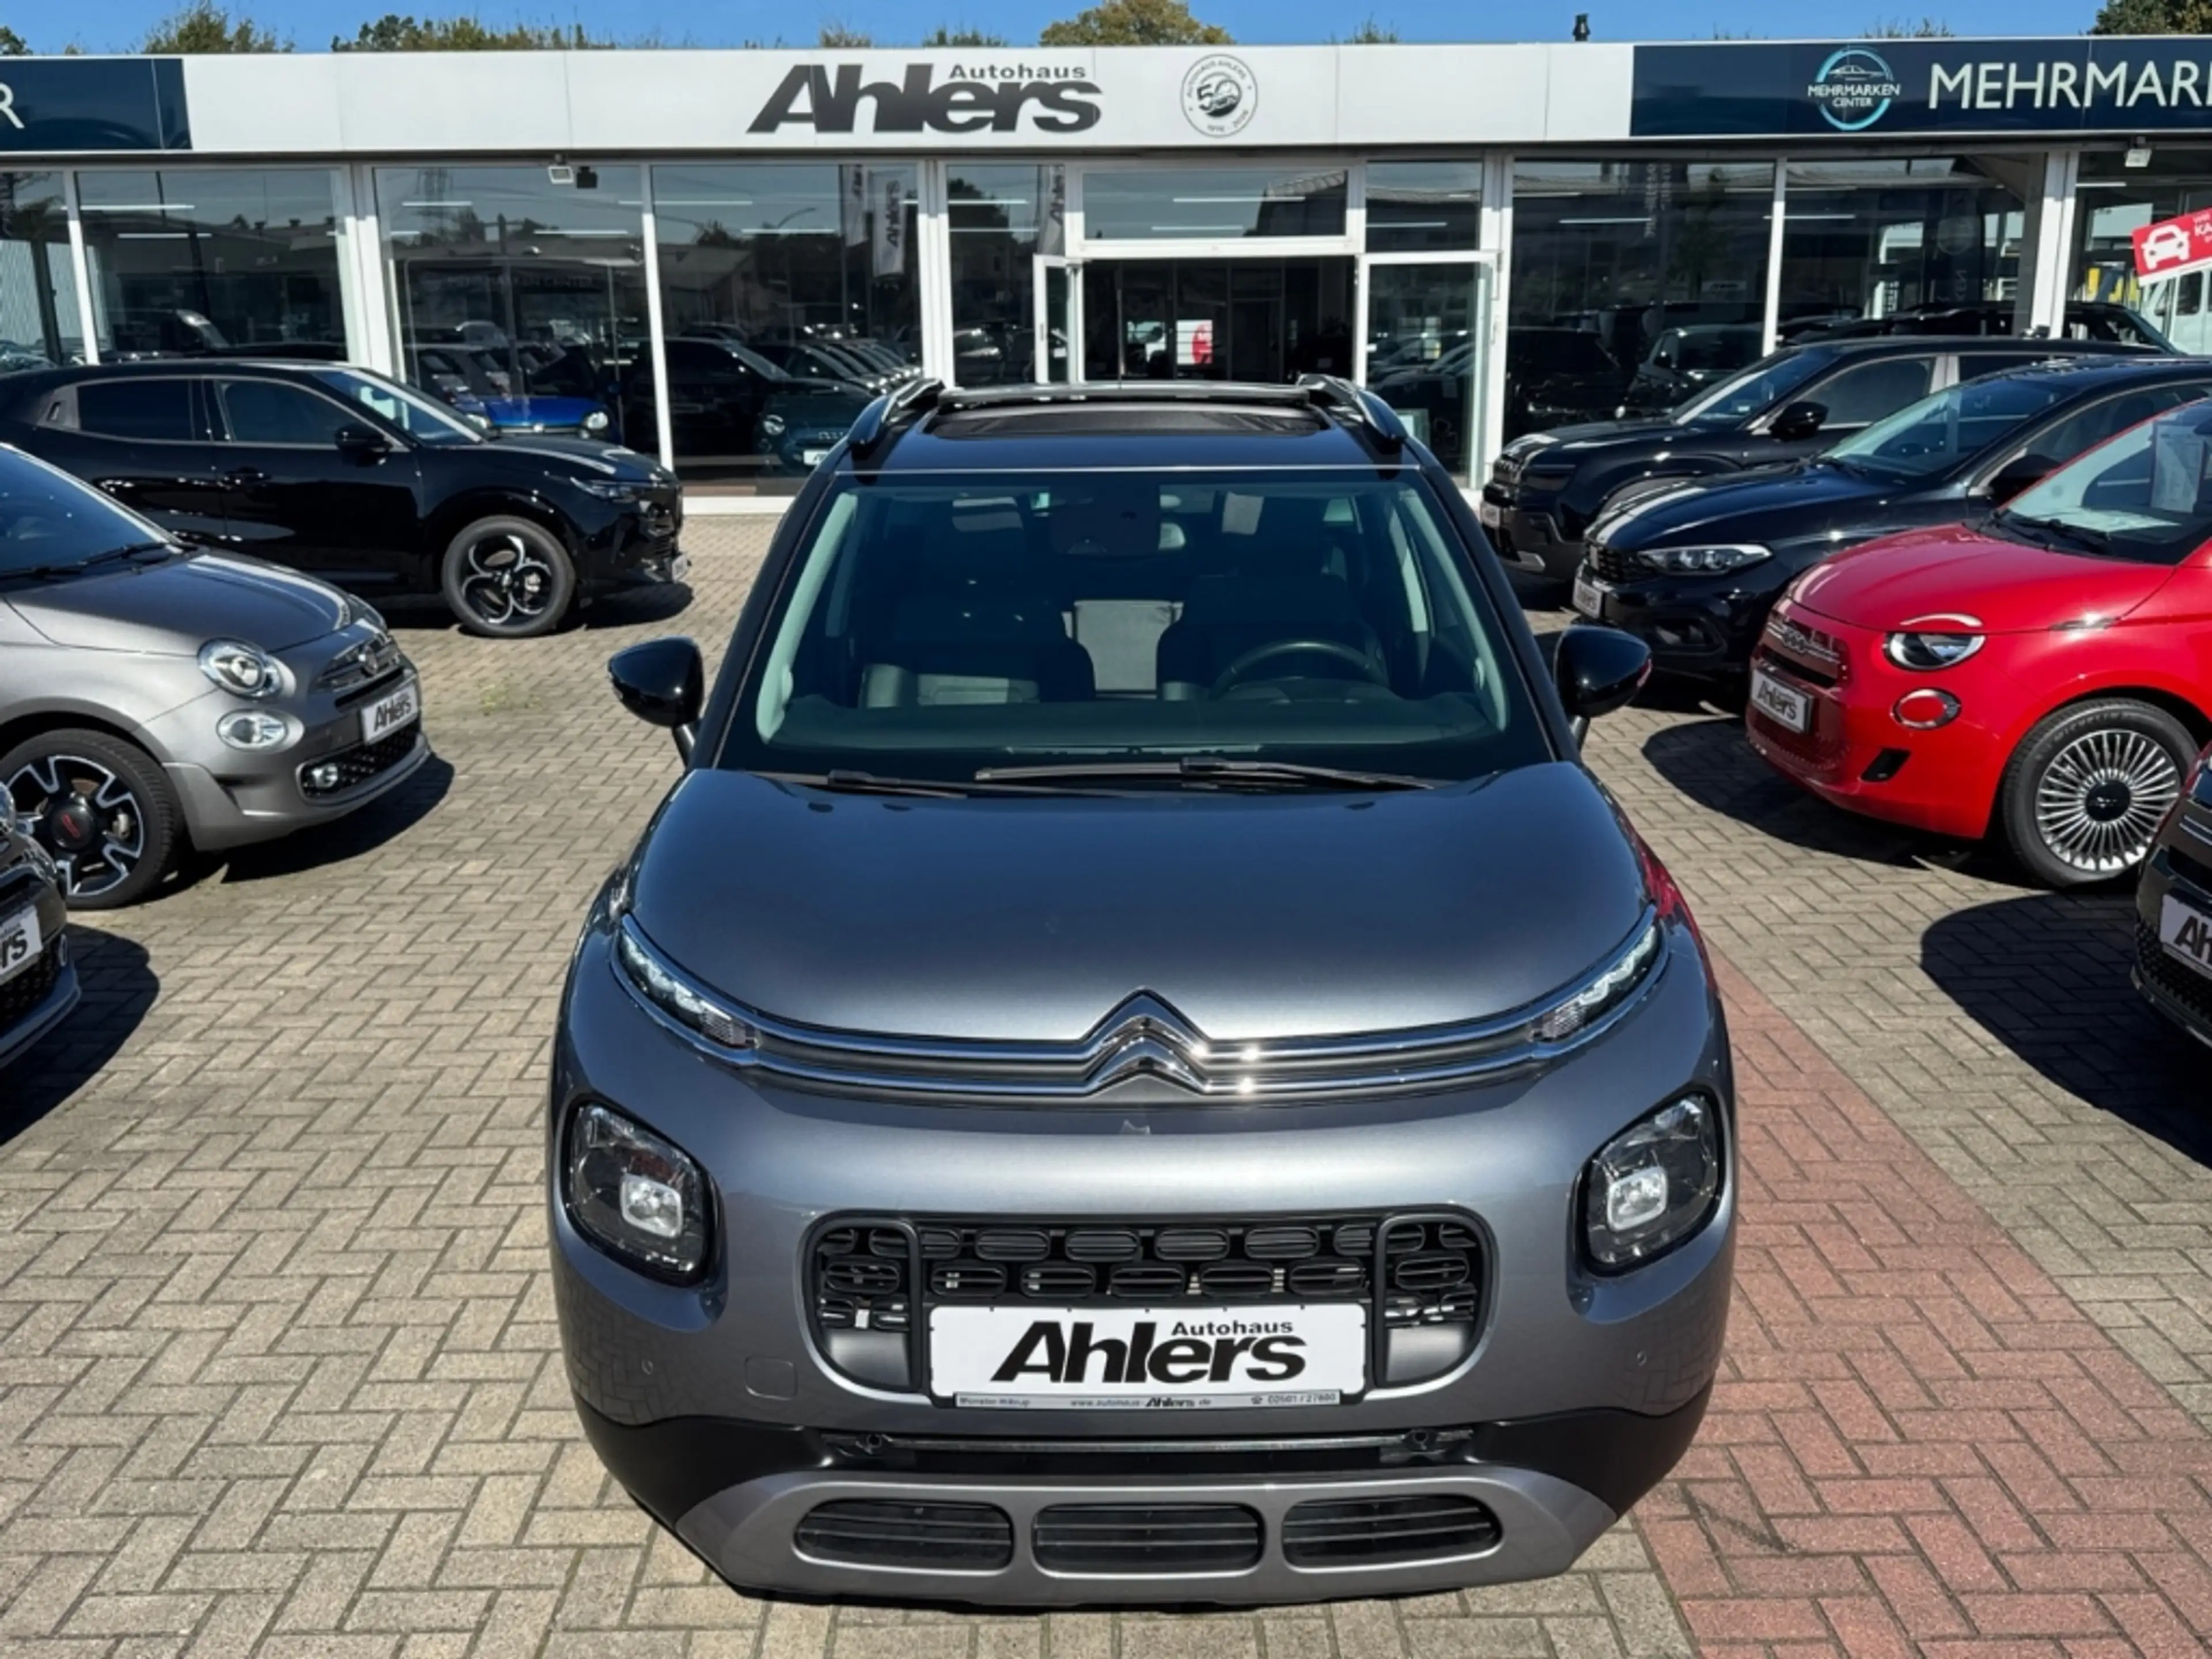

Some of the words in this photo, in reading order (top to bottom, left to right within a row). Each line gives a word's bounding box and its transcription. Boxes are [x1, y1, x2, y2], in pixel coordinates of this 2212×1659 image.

[948, 64, 1086, 79] Autohaus
[1808, 84, 1900, 97] MEHRMARKEN
[1928, 60, 2212, 109] MEHRMAR
[745, 63, 1103, 134] Ahlers
[1832, 97, 1873, 108] CENTER
[1171, 1321, 1293, 1335] Autohaus
[990, 1321, 1308, 1383] Ahlers
